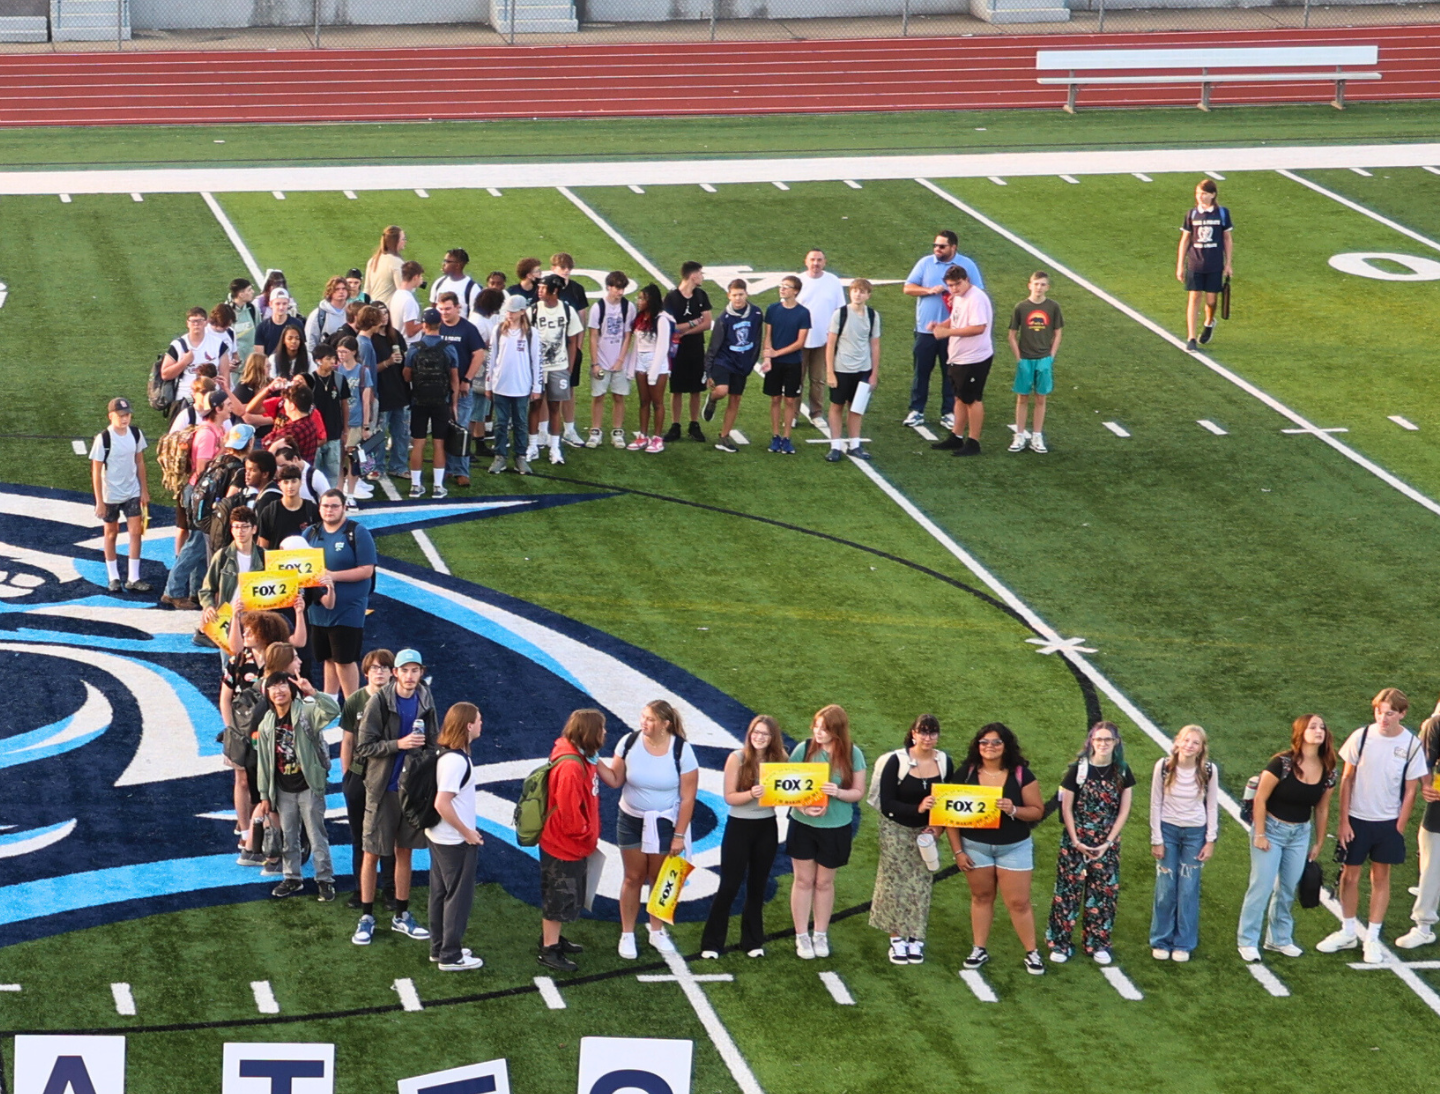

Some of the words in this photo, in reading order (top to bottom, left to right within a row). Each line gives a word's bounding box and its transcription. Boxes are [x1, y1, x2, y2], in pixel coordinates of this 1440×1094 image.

[305, 563, 313, 573] 2
[252, 585, 277, 597] FOX
[279, 584, 287, 595] 2
[774, 779, 801, 791] FOX
[805, 779, 813, 791] 2
[945, 800, 973, 813] FOX
[977, 801, 986, 813] 2
[658, 881, 674, 907] FOX
[669, 869, 679, 879] 2
